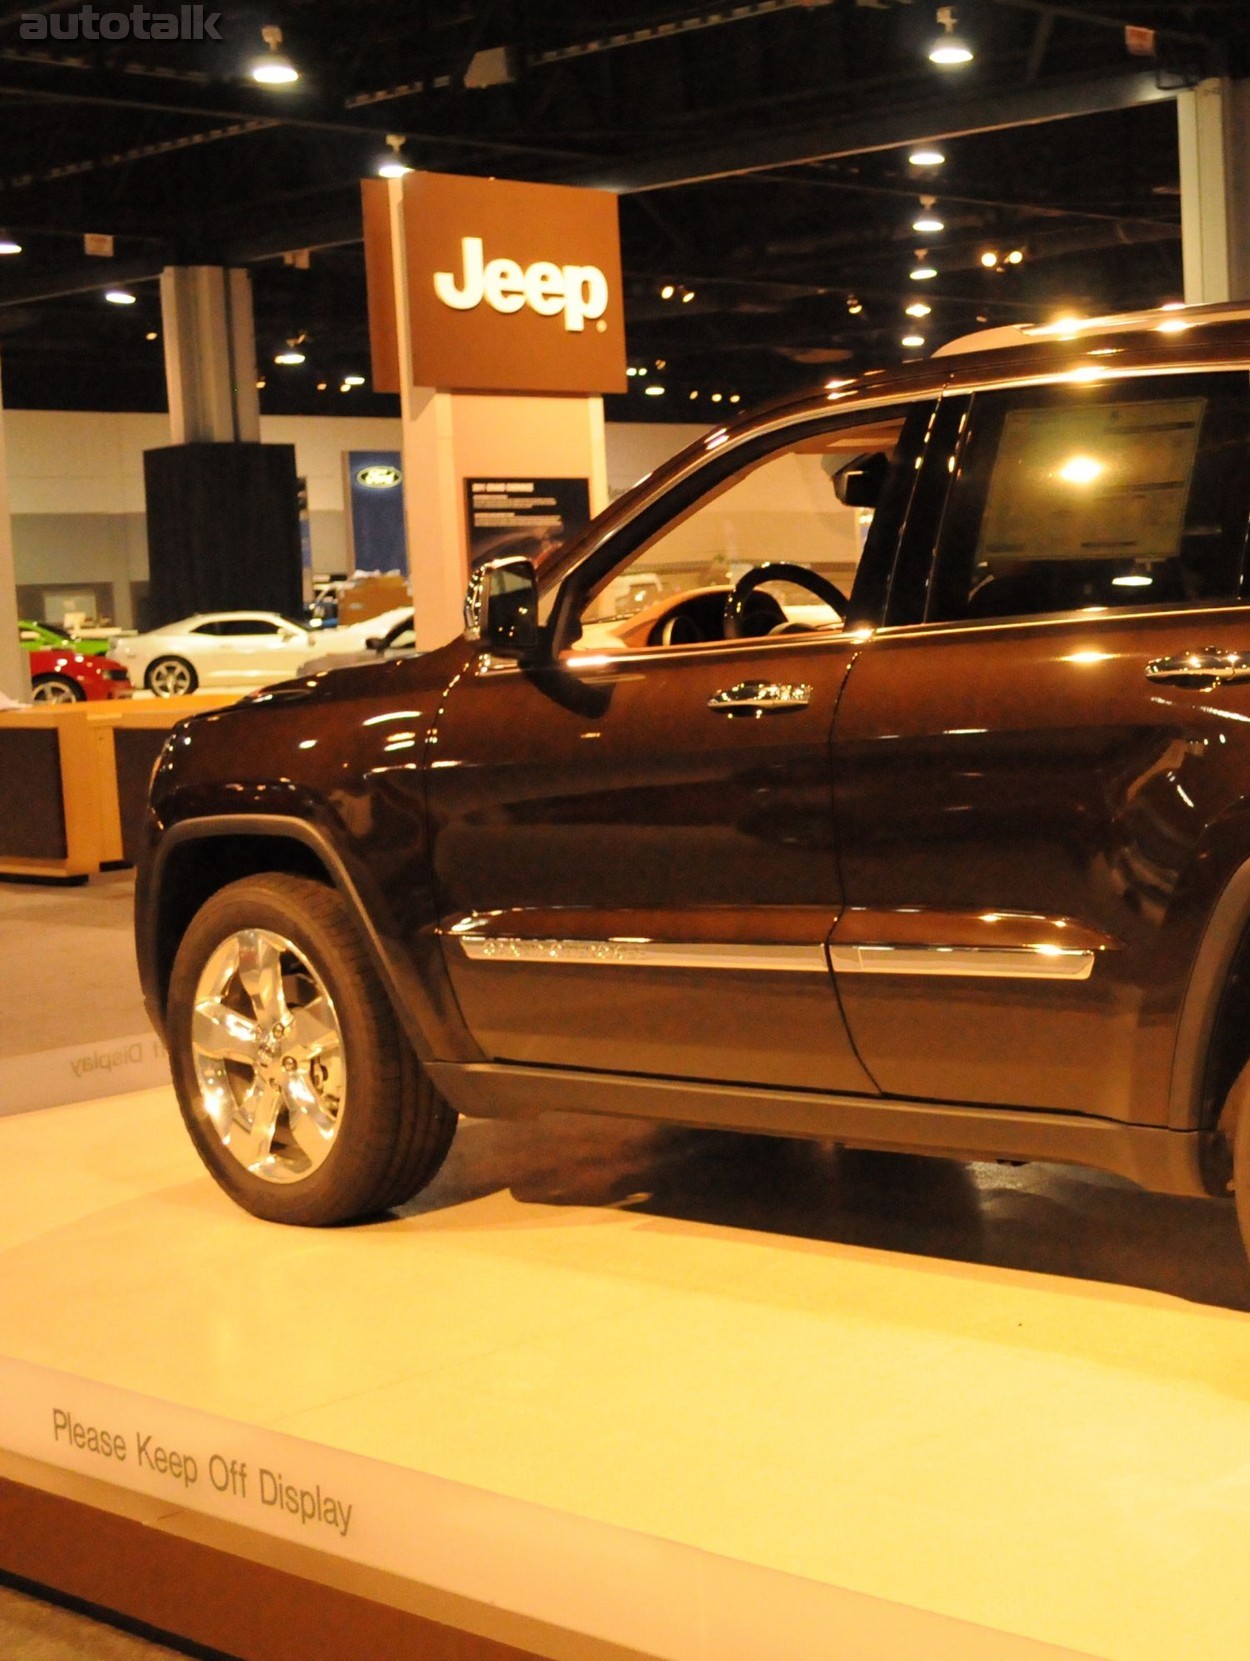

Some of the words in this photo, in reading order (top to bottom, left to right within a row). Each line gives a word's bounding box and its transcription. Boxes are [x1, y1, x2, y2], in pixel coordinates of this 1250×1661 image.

[433, 236, 609, 332] Jeep
[52, 1407, 127, 1461] Please
[136, 1432, 198, 1488] Keep
[209, 1454, 247, 1498] Off
[259, 1468, 353, 1537] Display
